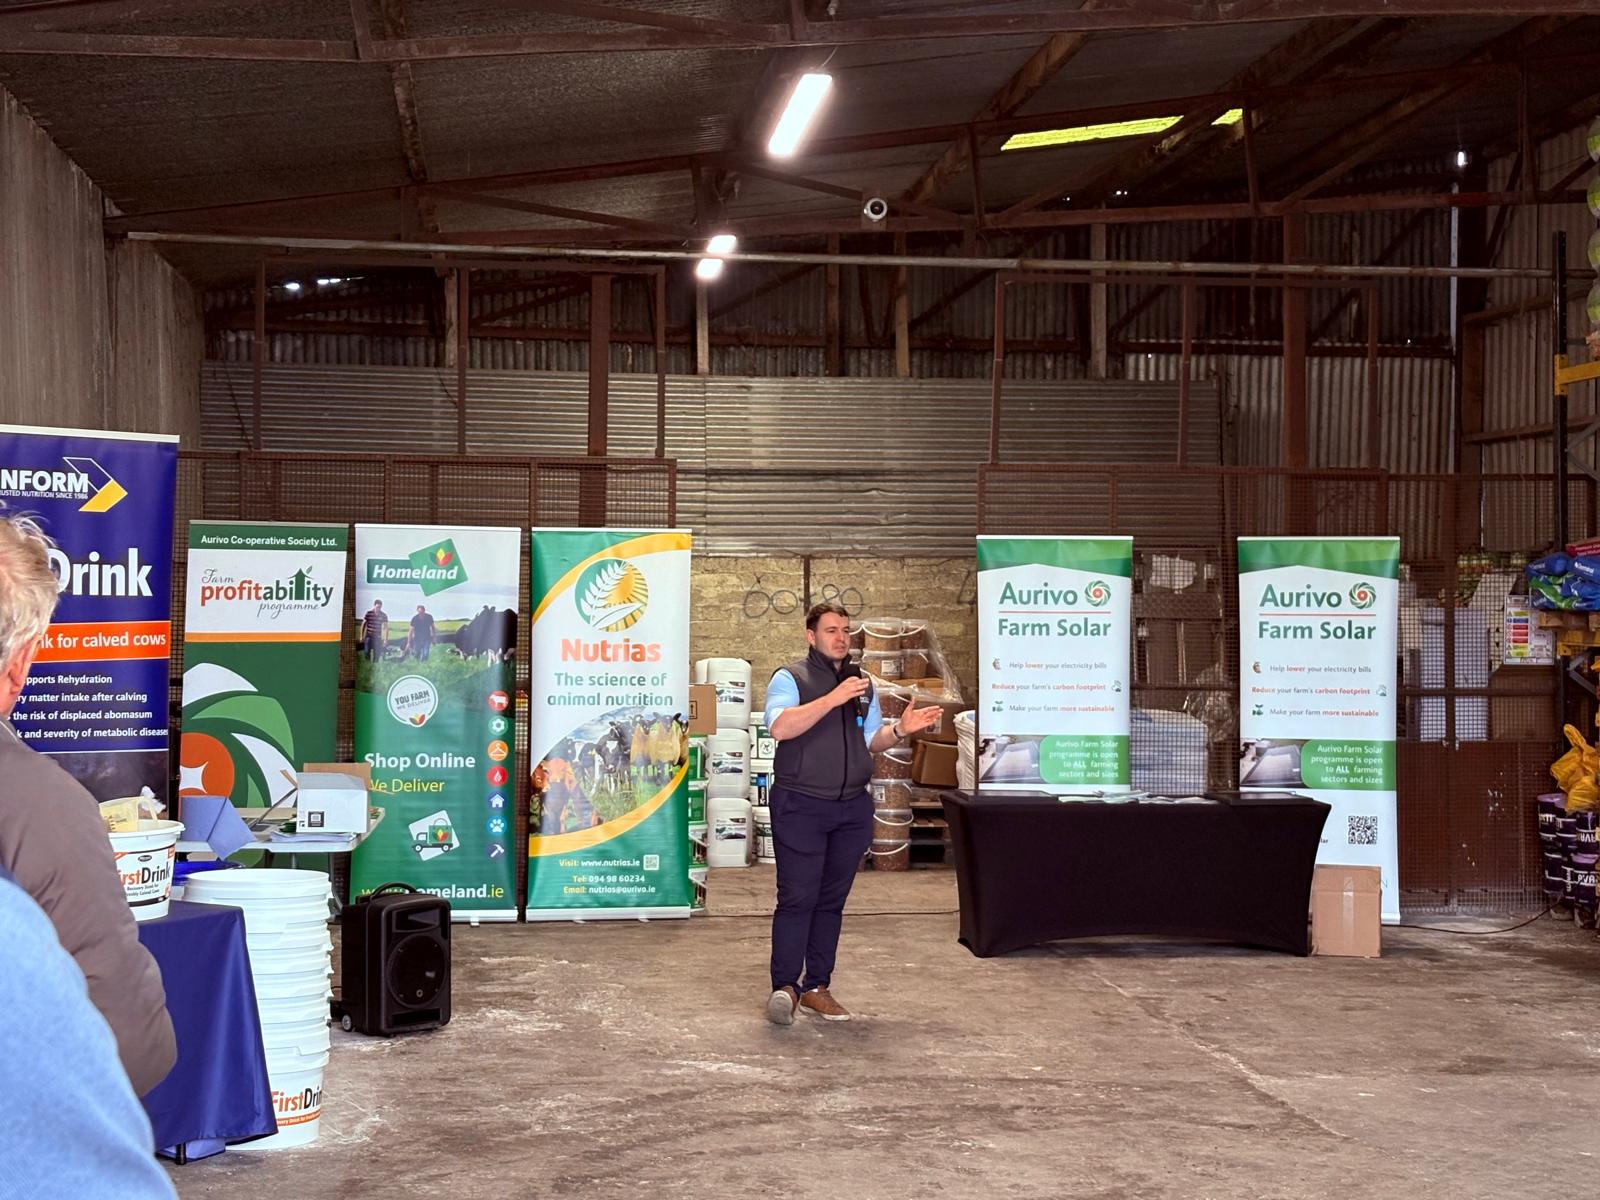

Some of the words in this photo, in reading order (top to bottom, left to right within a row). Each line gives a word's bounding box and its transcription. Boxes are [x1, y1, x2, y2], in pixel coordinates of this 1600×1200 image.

[0, 469, 88, 492] NFORM
[201, 535, 228, 544] Aurivo
[230, 536, 286, 546] Co-operative
[288, 536, 320, 548] Society
[321, 538, 338, 546] Ltd.
[202, 568, 234, 584] Farm
[373, 565, 458, 580] Homeland
[200, 568, 334, 608] profitability
[998, 582, 1078, 606] Aurivo
[1259, 584, 1342, 608] Aurivo
[257, 601, 319, 619] programme
[998, 618, 1050, 636] Farm
[1057, 618, 1112, 636] Solar
[1258, 621, 1312, 639] Farm
[1320, 620, 1376, 640] Solar
[58, 633, 79, 648] for
[82, 632, 128, 647] calved
[133, 634, 166, 646] cows
[561, 638, 662, 662] Nutrias
[58, 675, 112, 686] Rehydration
[554, 672, 584, 686] The
[588, 672, 646, 686] science
[650, 672, 668, 686] of
[17, 694, 27, 704] ry
[62, 692, 90, 702] intake
[91, 692, 114, 701] after
[115, 692, 147, 703] calving
[395, 696, 410, 705] YOU
[410, 690, 430, 701] FARM
[548, 692, 600, 706] animal
[606, 692, 673, 706] nutrition
[13, 711, 28, 720] the
[30, 711, 46, 720] risk
[48, 710, 58, 720] of
[60, 710, 102, 721] displaced
[104, 710, 153, 719] abomasum
[24, 729, 42, 738] and
[44, 730, 79, 740] severity
[82, 728, 92, 737] of
[94, 728, 137, 737] metabolic
[1317, 745, 1342, 753] Aurivo
[1344, 745, 1362, 753] Farm
[365, 752, 411, 771] Shop
[416, 752, 476, 768] Online
[1354, 765, 1383, 775] farming
[392, 778, 444, 792] Deliver
[116, 862, 170, 885] irstDrink
[588, 885, 656, 894] nutrias@aurivo.ie
